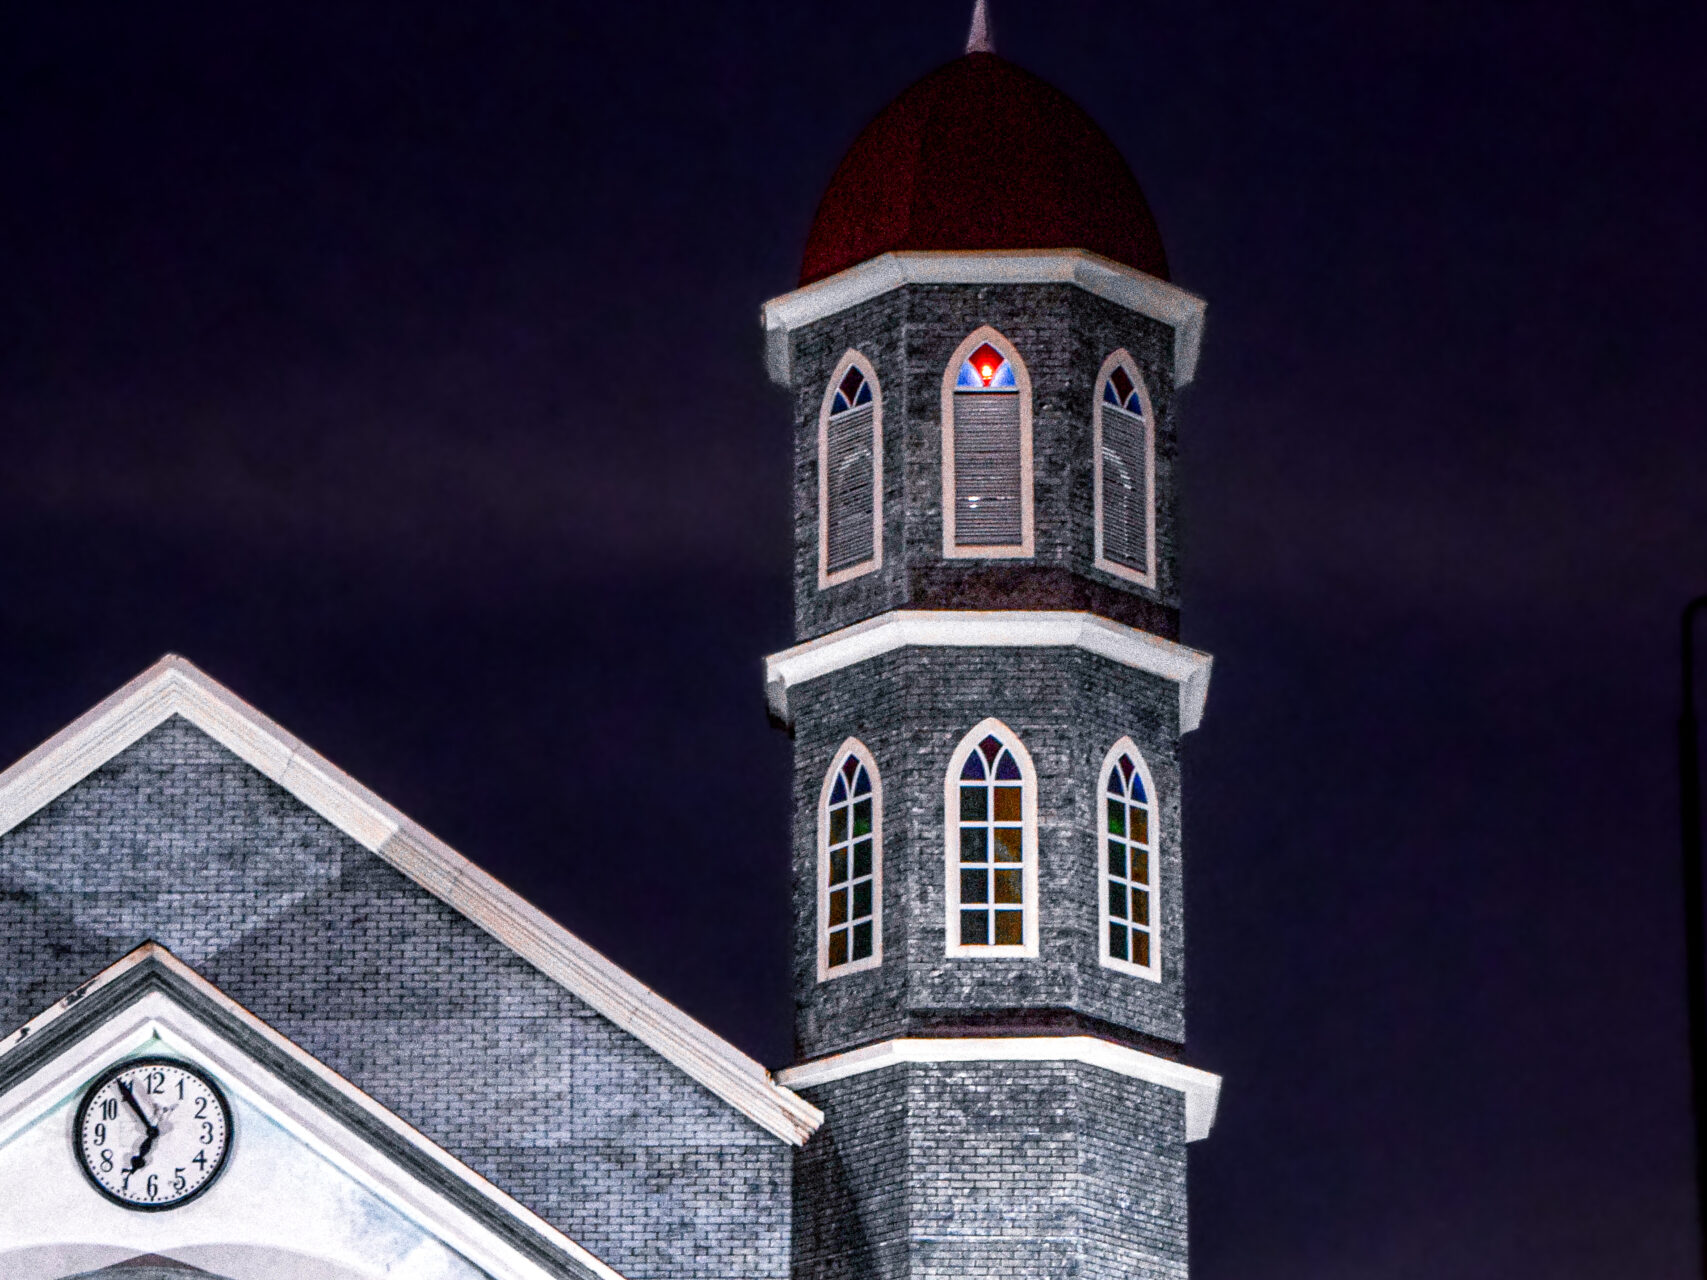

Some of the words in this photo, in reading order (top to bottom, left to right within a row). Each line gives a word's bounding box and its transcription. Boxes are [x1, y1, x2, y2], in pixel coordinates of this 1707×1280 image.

[144, 1072, 165, 1094] 12
[175, 1078, 184, 1100] 1
[100, 1098, 117, 1120] 10
[194, 1097, 207, 1119] 2
[94, 1123, 105, 1146] 9
[200, 1122, 213, 1144] 3
[100, 1149, 113, 1172] 8
[192, 1149, 207, 1171] 4
[121, 1168, 133, 1190] 7
[147, 1174, 158, 1198] 6
[174, 1168, 186, 1190] 5
